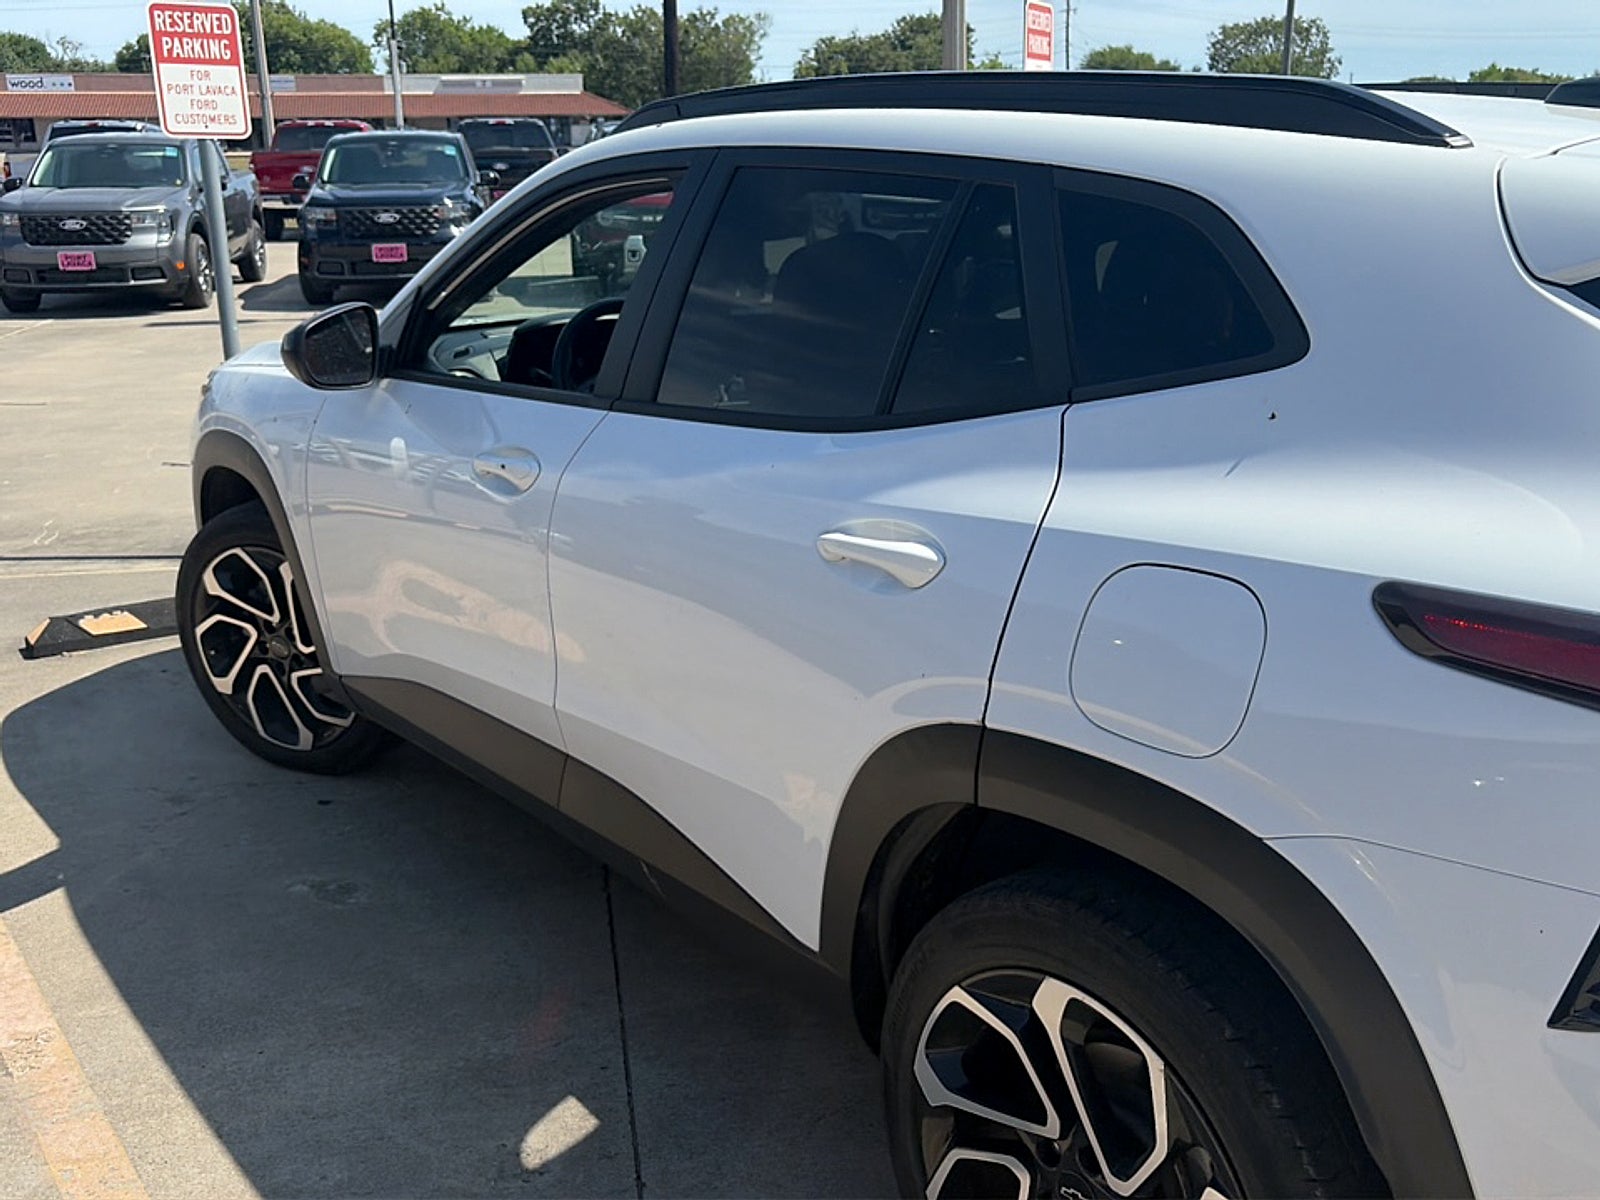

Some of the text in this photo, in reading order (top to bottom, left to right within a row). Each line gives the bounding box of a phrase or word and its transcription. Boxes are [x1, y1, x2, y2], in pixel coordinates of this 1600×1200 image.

[153, 9, 232, 35] RESERVED
[161, 36, 231, 60] PARKING
[190, 70, 211, 81] FOR
[166, 83, 238, 96] PORT LAVACA
[189, 98, 218, 110] FORD
[174, 113, 238, 125] CUSTOMERS
